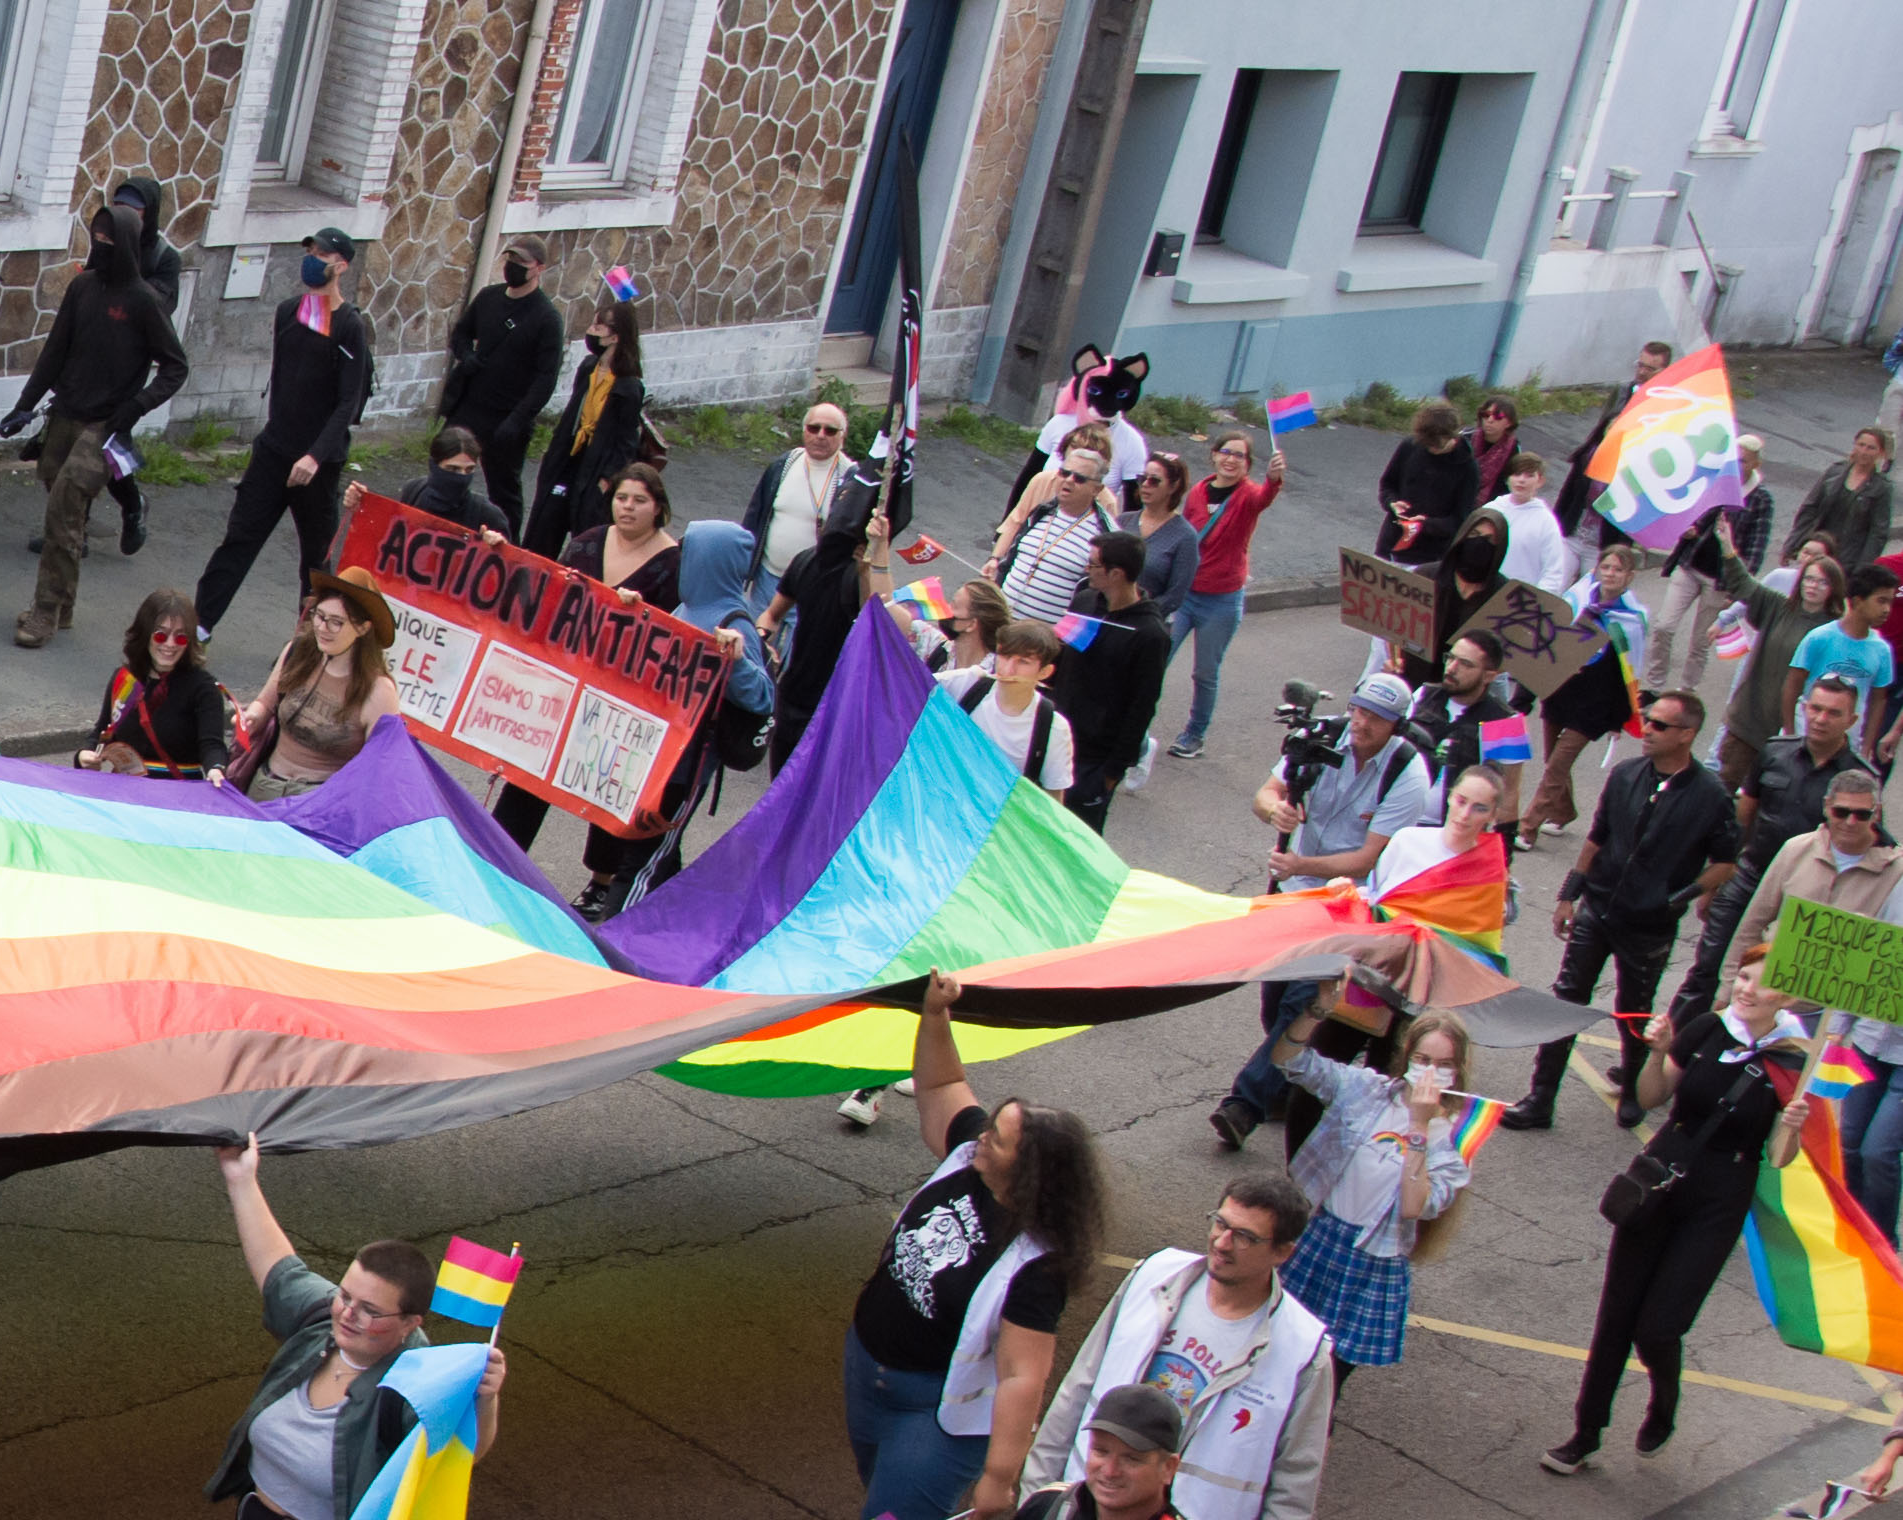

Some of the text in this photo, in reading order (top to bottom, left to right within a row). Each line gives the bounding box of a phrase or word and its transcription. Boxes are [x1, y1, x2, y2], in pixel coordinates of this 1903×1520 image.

[377, 518, 549, 632] ACTION
[1341, 553, 1433, 608] NO MORE
[401, 647, 437, 684] LE
[481, 674, 534, 711] SIAMO
[582, 694, 602, 729] VA
[603, 704, 627, 740] TE
[561, 758, 591, 792] UN
